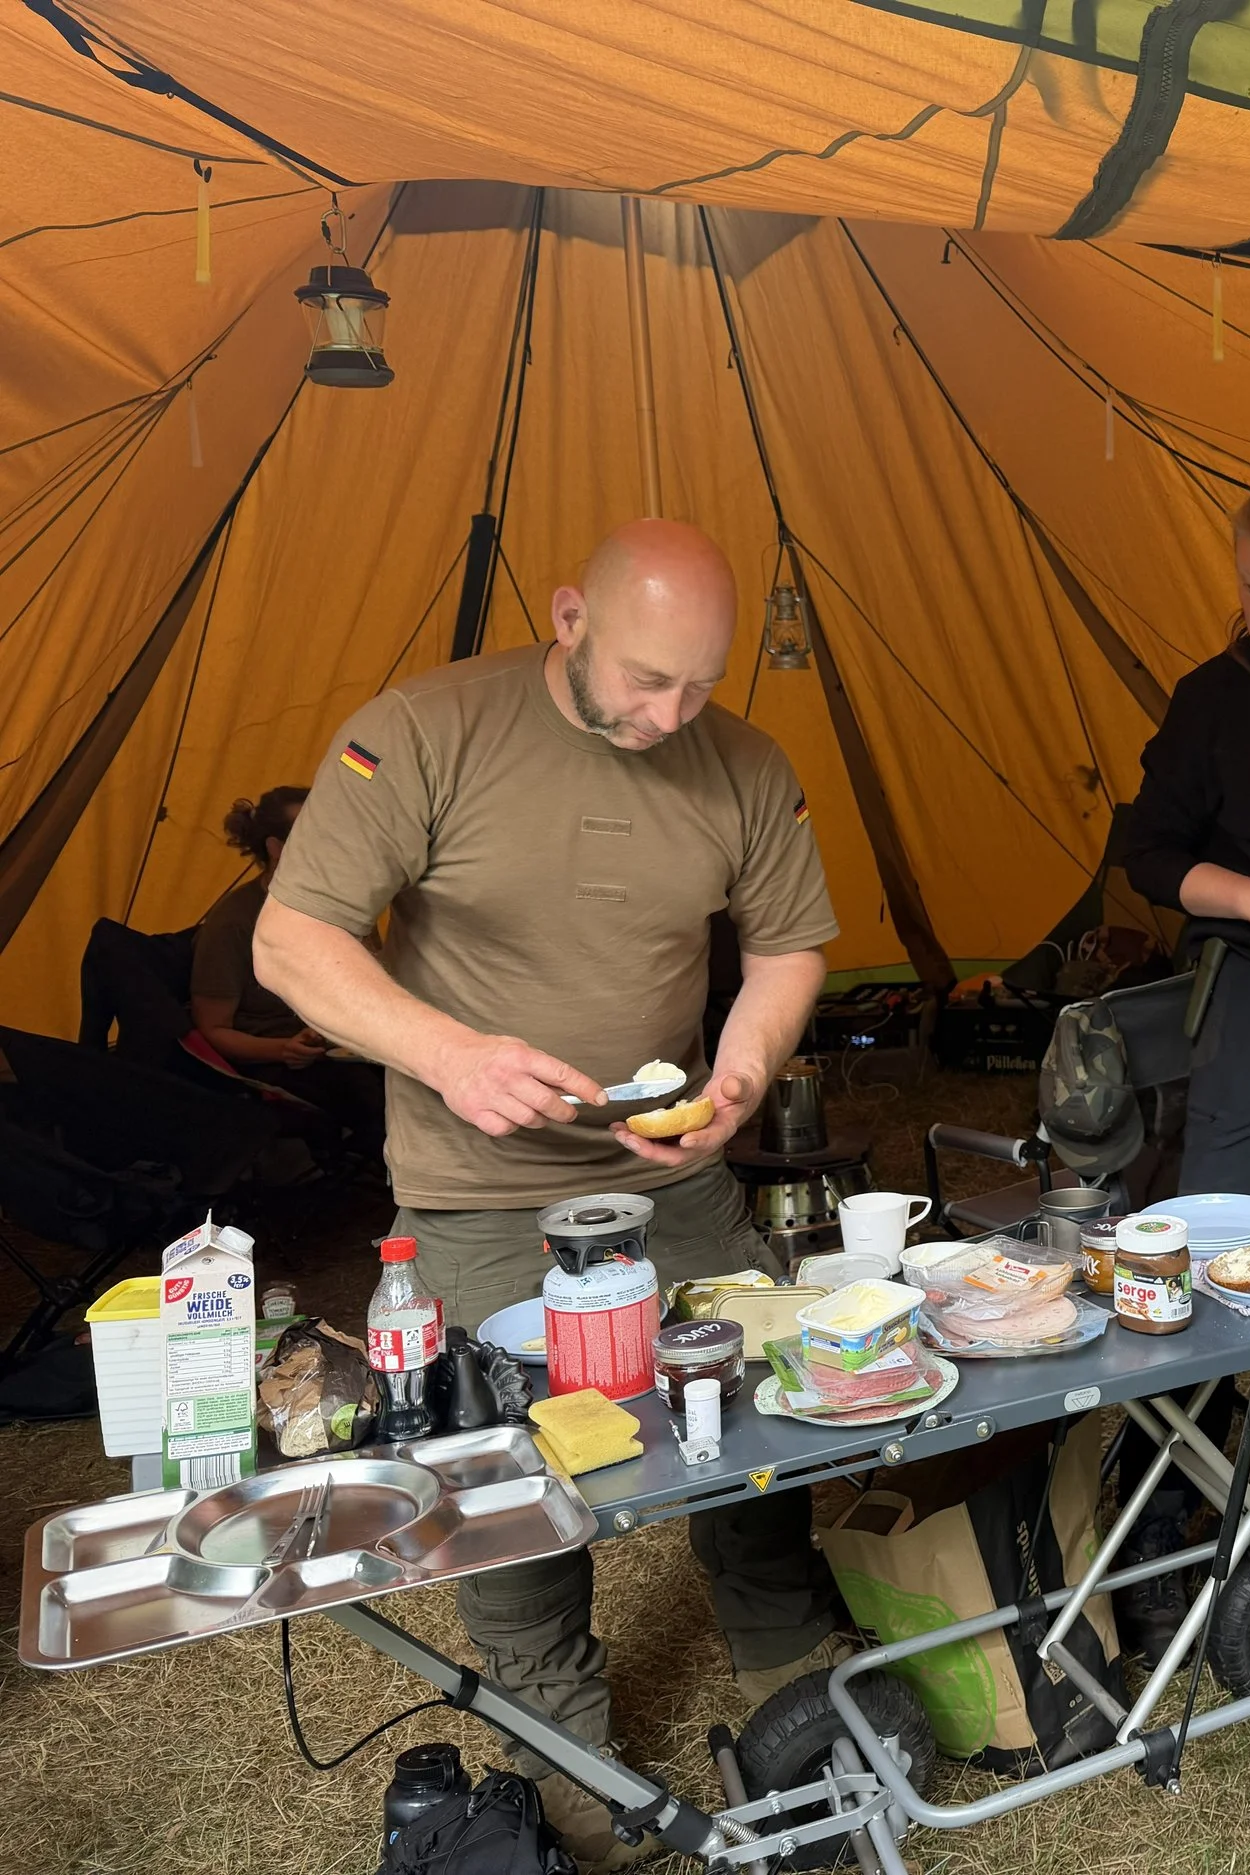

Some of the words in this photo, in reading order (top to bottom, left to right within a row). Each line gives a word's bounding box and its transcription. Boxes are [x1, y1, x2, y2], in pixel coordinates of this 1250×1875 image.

[230, 1275, 249, 1284] 3,5%
[167, 1279, 190, 1301] GÜNSTIG
[192, 1290, 227, 1300] FRISCHE
[1117, 1281, 1157, 1303] serge
[186, 1297, 233, 1313] WEIDE
[187, 1310, 233, 1320] VOLLMILCH
